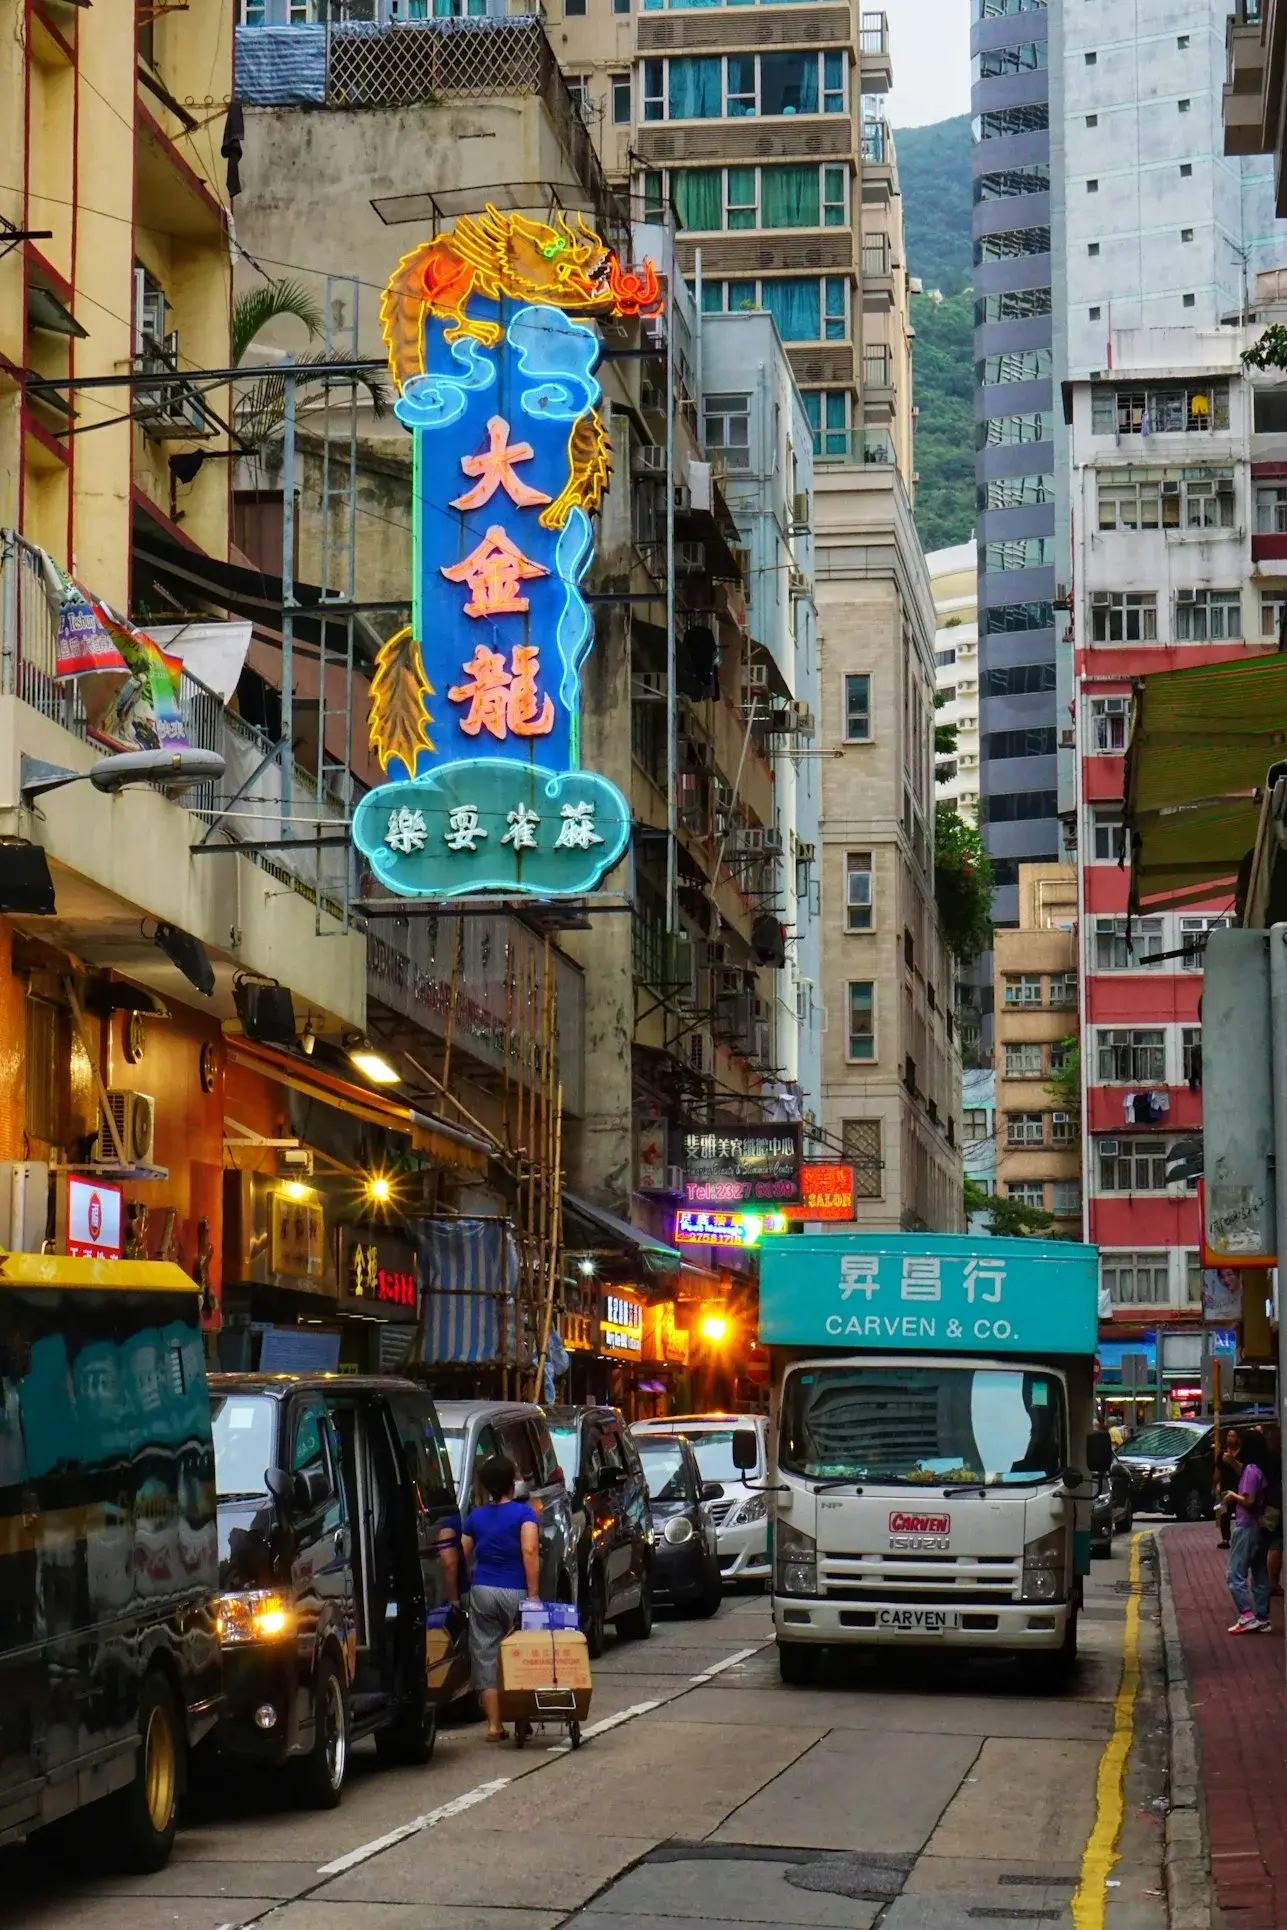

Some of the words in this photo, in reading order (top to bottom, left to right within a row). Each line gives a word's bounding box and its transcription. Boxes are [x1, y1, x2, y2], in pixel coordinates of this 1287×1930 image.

[440, 415, 555, 738] 大金龍
[808, 1192, 853, 1208] SALON
[838, 1256, 1007, 1303] 昇昌行
[825, 1315, 937, 1338] CARVEN
[946, 1319, 963, 1339] &
[973, 1319, 1020, 1341] CO.
[892, 1513, 948, 1532] CARVEN
[889, 1536, 950, 1551] ISUZU
[880, 1610, 946, 1627] CARVEN
